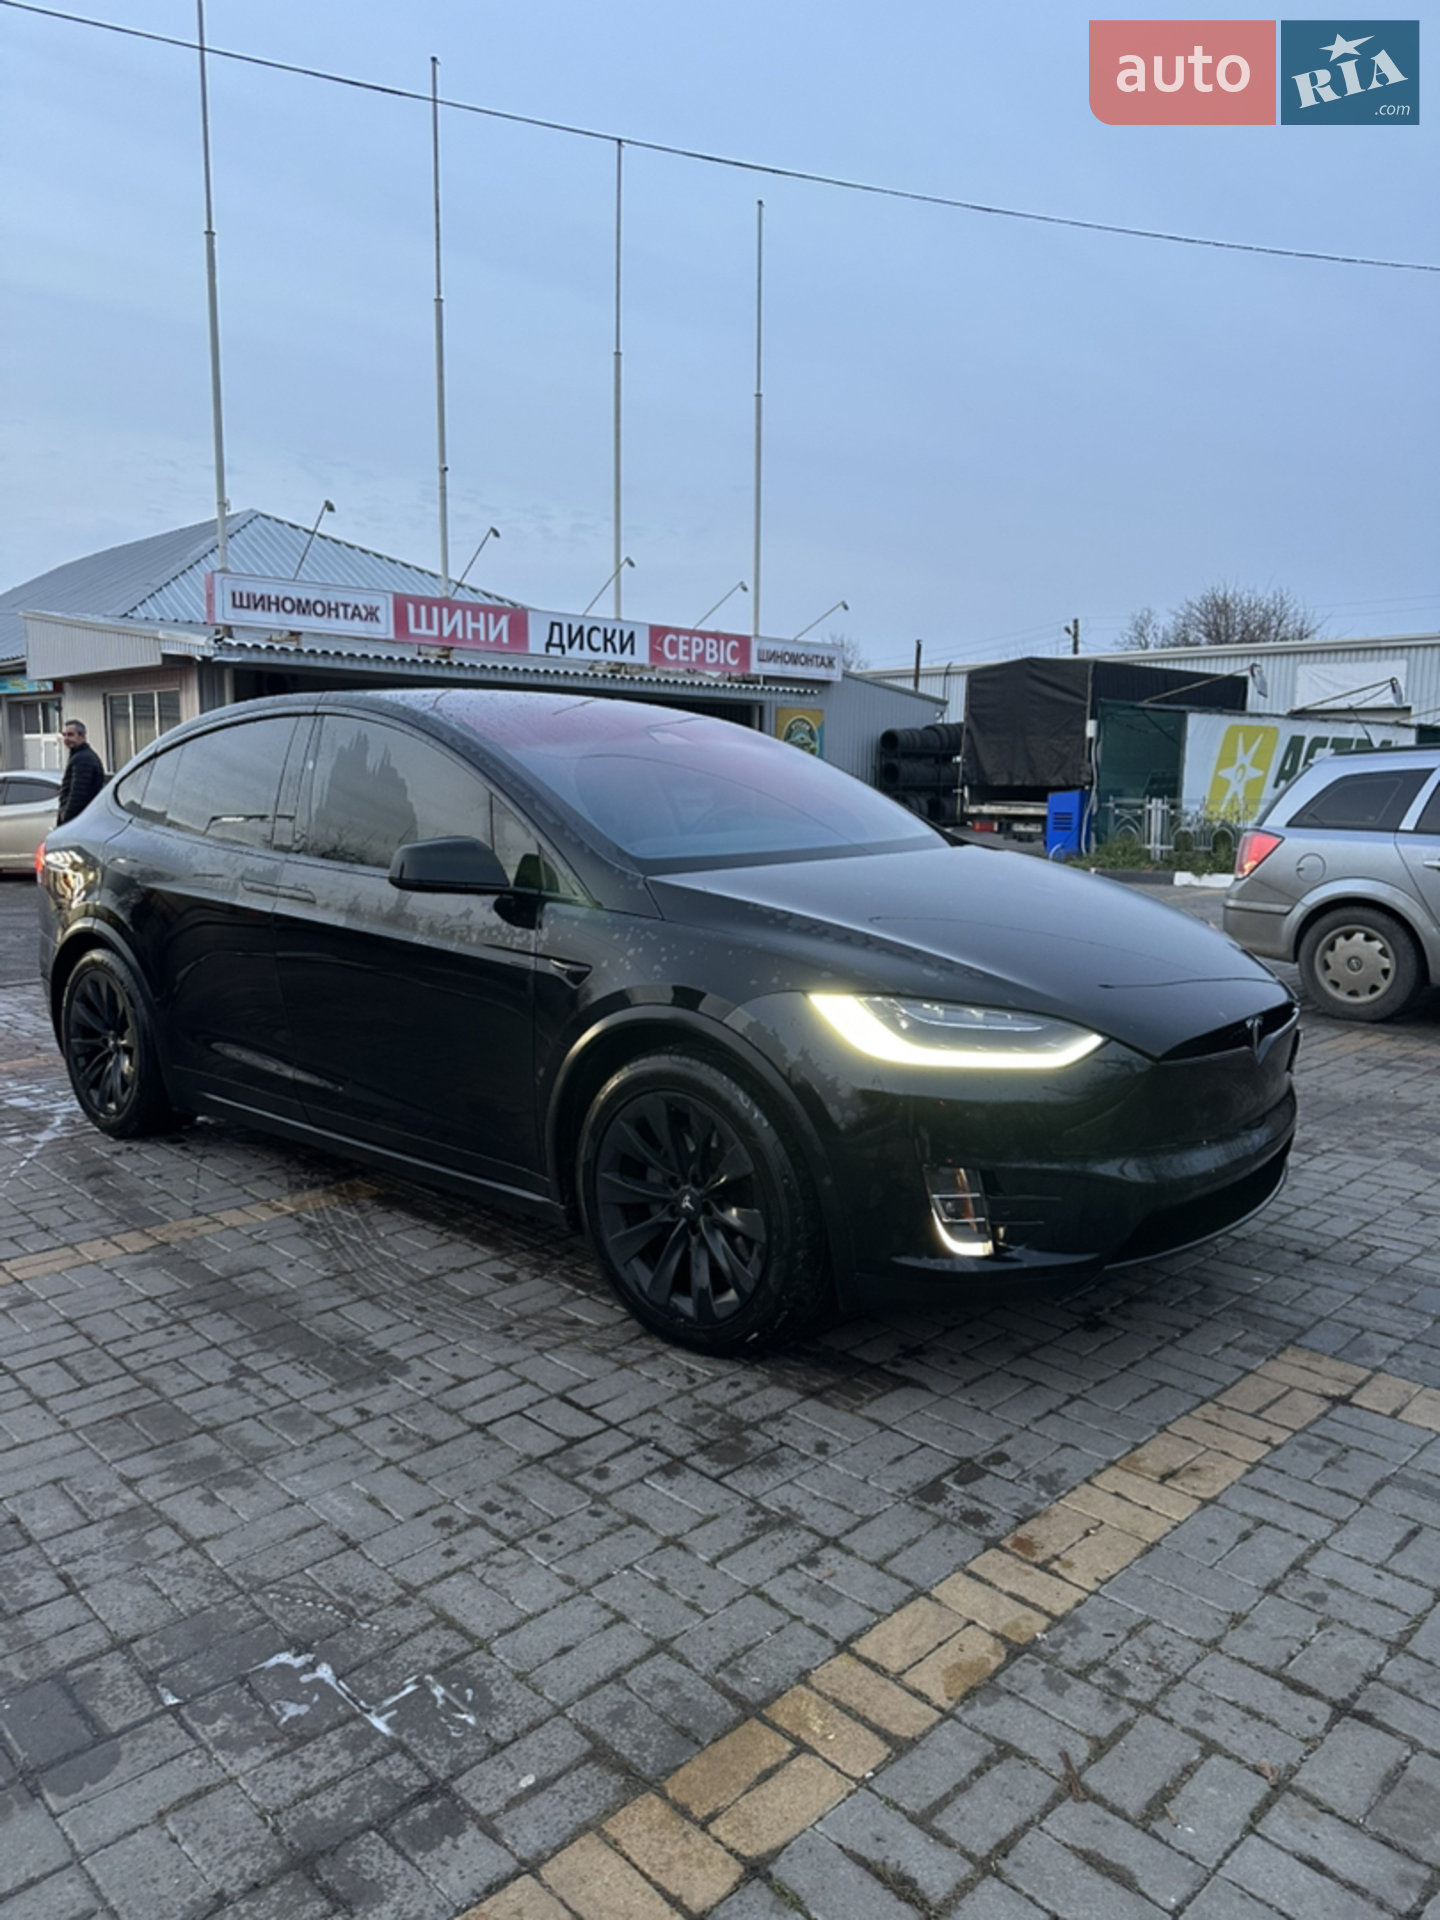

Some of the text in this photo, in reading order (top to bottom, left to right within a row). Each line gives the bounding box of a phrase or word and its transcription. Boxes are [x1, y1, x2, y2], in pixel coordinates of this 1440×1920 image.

[231, 590, 381, 624] ШИНОМОНТАЖ
[406, 602, 510, 644] ШИНИ
[545, 621, 636, 656] ДИСКИ
[662, 633, 740, 666] СЕРВІС
[756, 649, 836, 670] ШИНОМОНТАЖ
